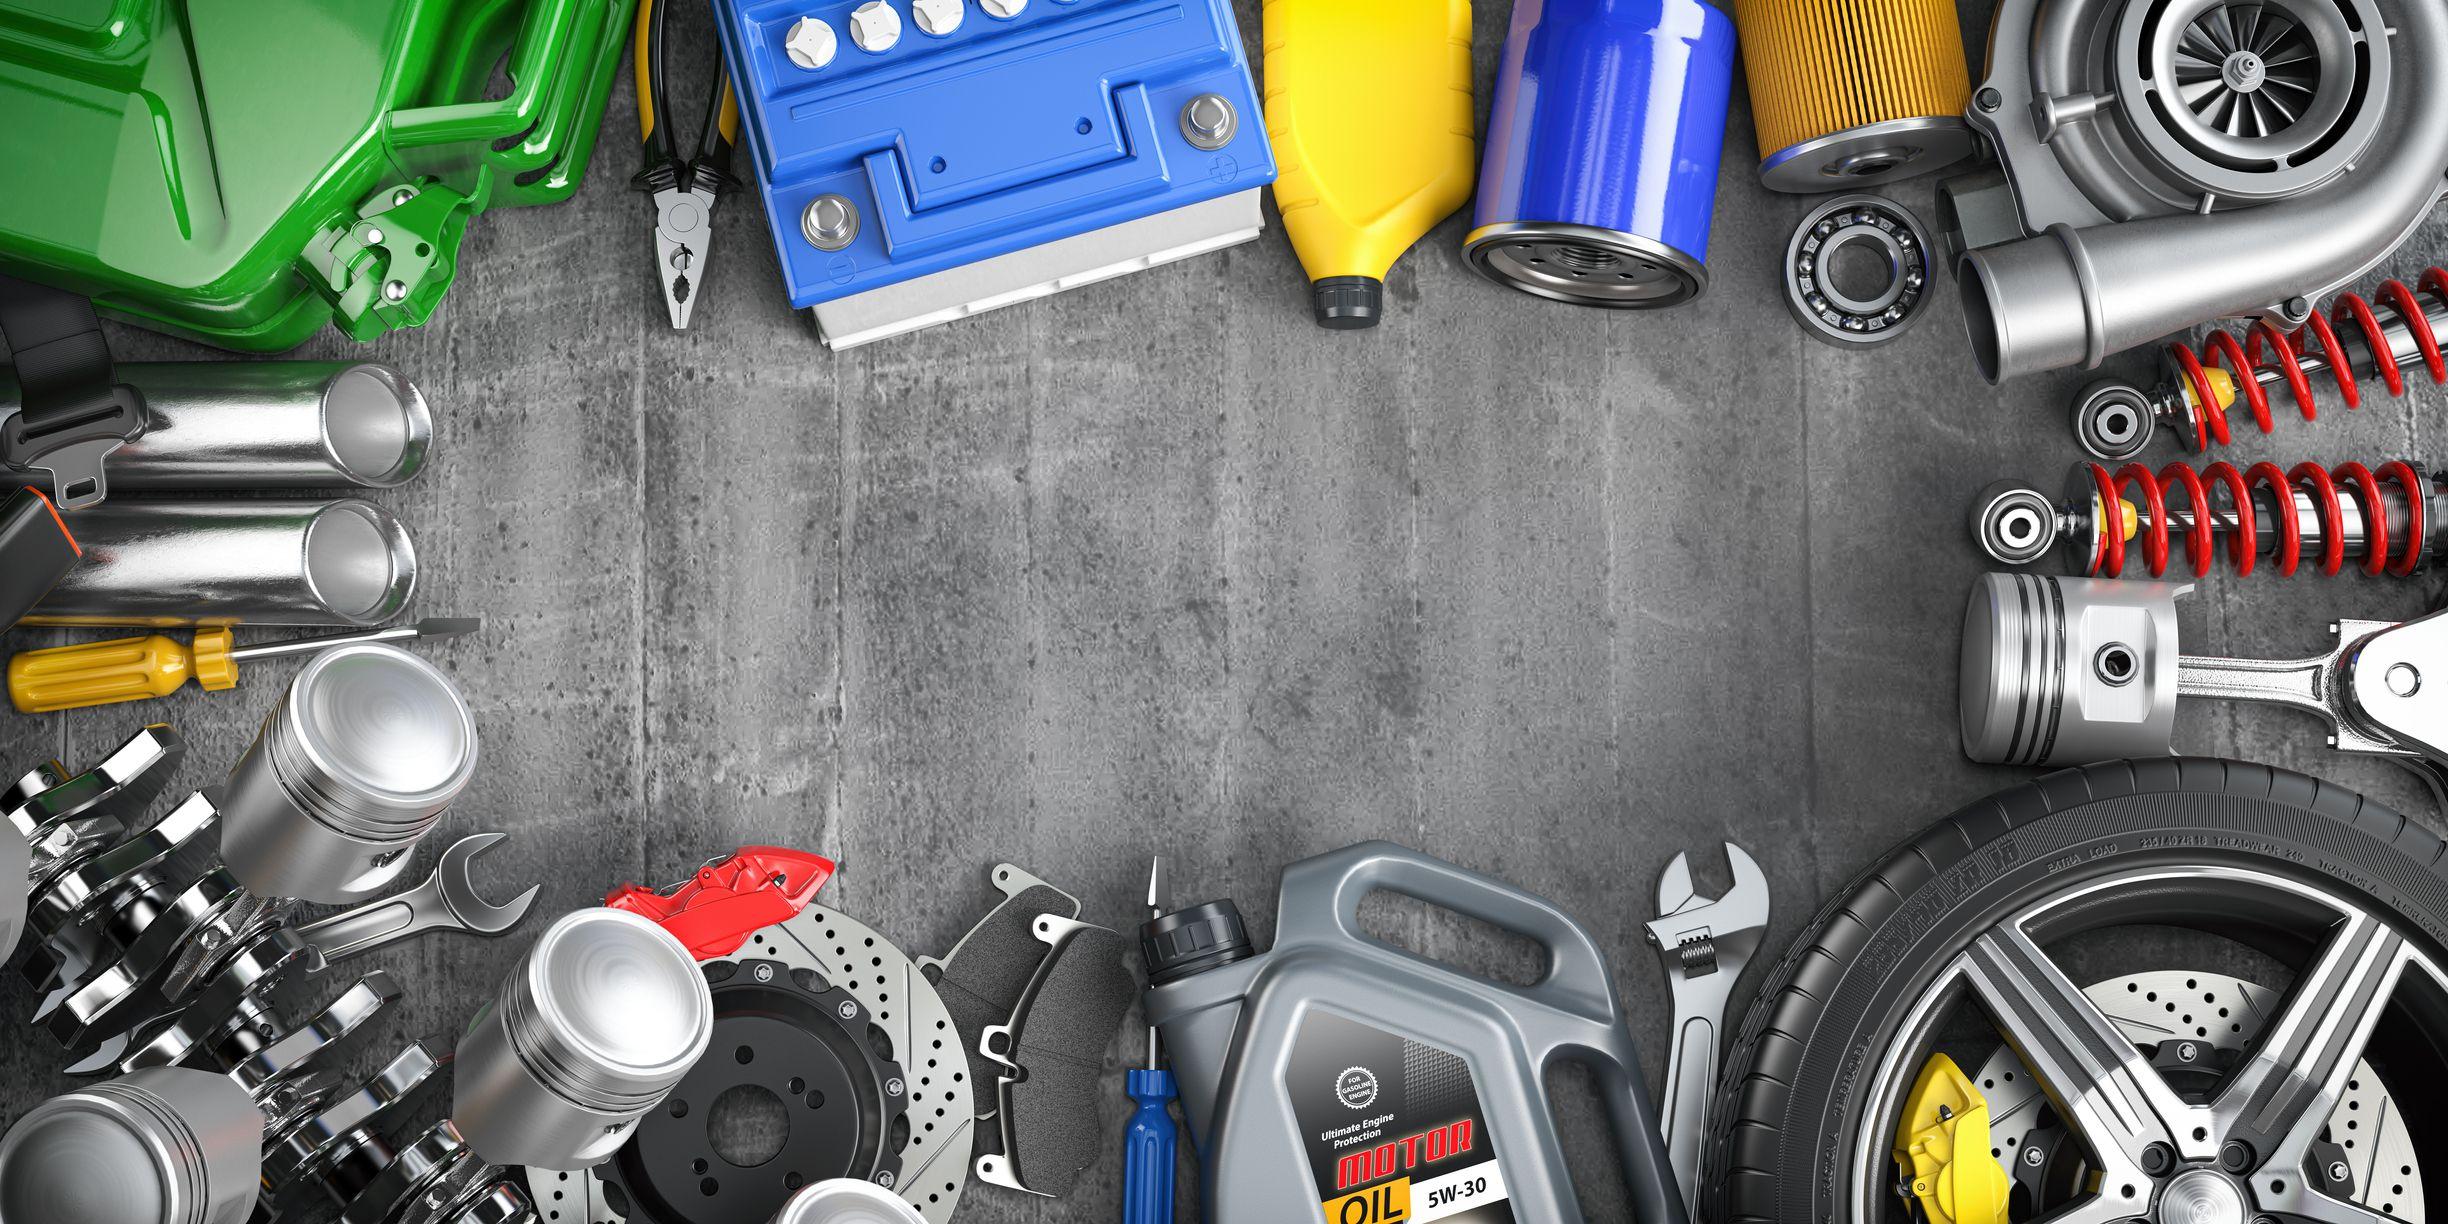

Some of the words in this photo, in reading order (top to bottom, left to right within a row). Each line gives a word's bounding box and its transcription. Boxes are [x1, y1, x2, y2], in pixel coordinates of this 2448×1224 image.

[2047, 853, 2081, 873] EXTRA
[2089, 843, 2118, 859] LOAD
[2214, 836, 2280, 856] TREADWEAR
[1342, 1081, 1371, 1094] GASOLINE
[1348, 1076, 1361, 1084] FOR
[1349, 1089, 1371, 1100] ENGINE
[1321, 1123, 1360, 1141] Ultimate
[1362, 1113, 1394, 1129] Engine
[1334, 1129, 1381, 1149] Protection
[1337, 1119, 1472, 1190] MOTOR
[1428, 1176, 1486, 1208] 5W-30
[1340, 1186, 1403, 1224] OIL
